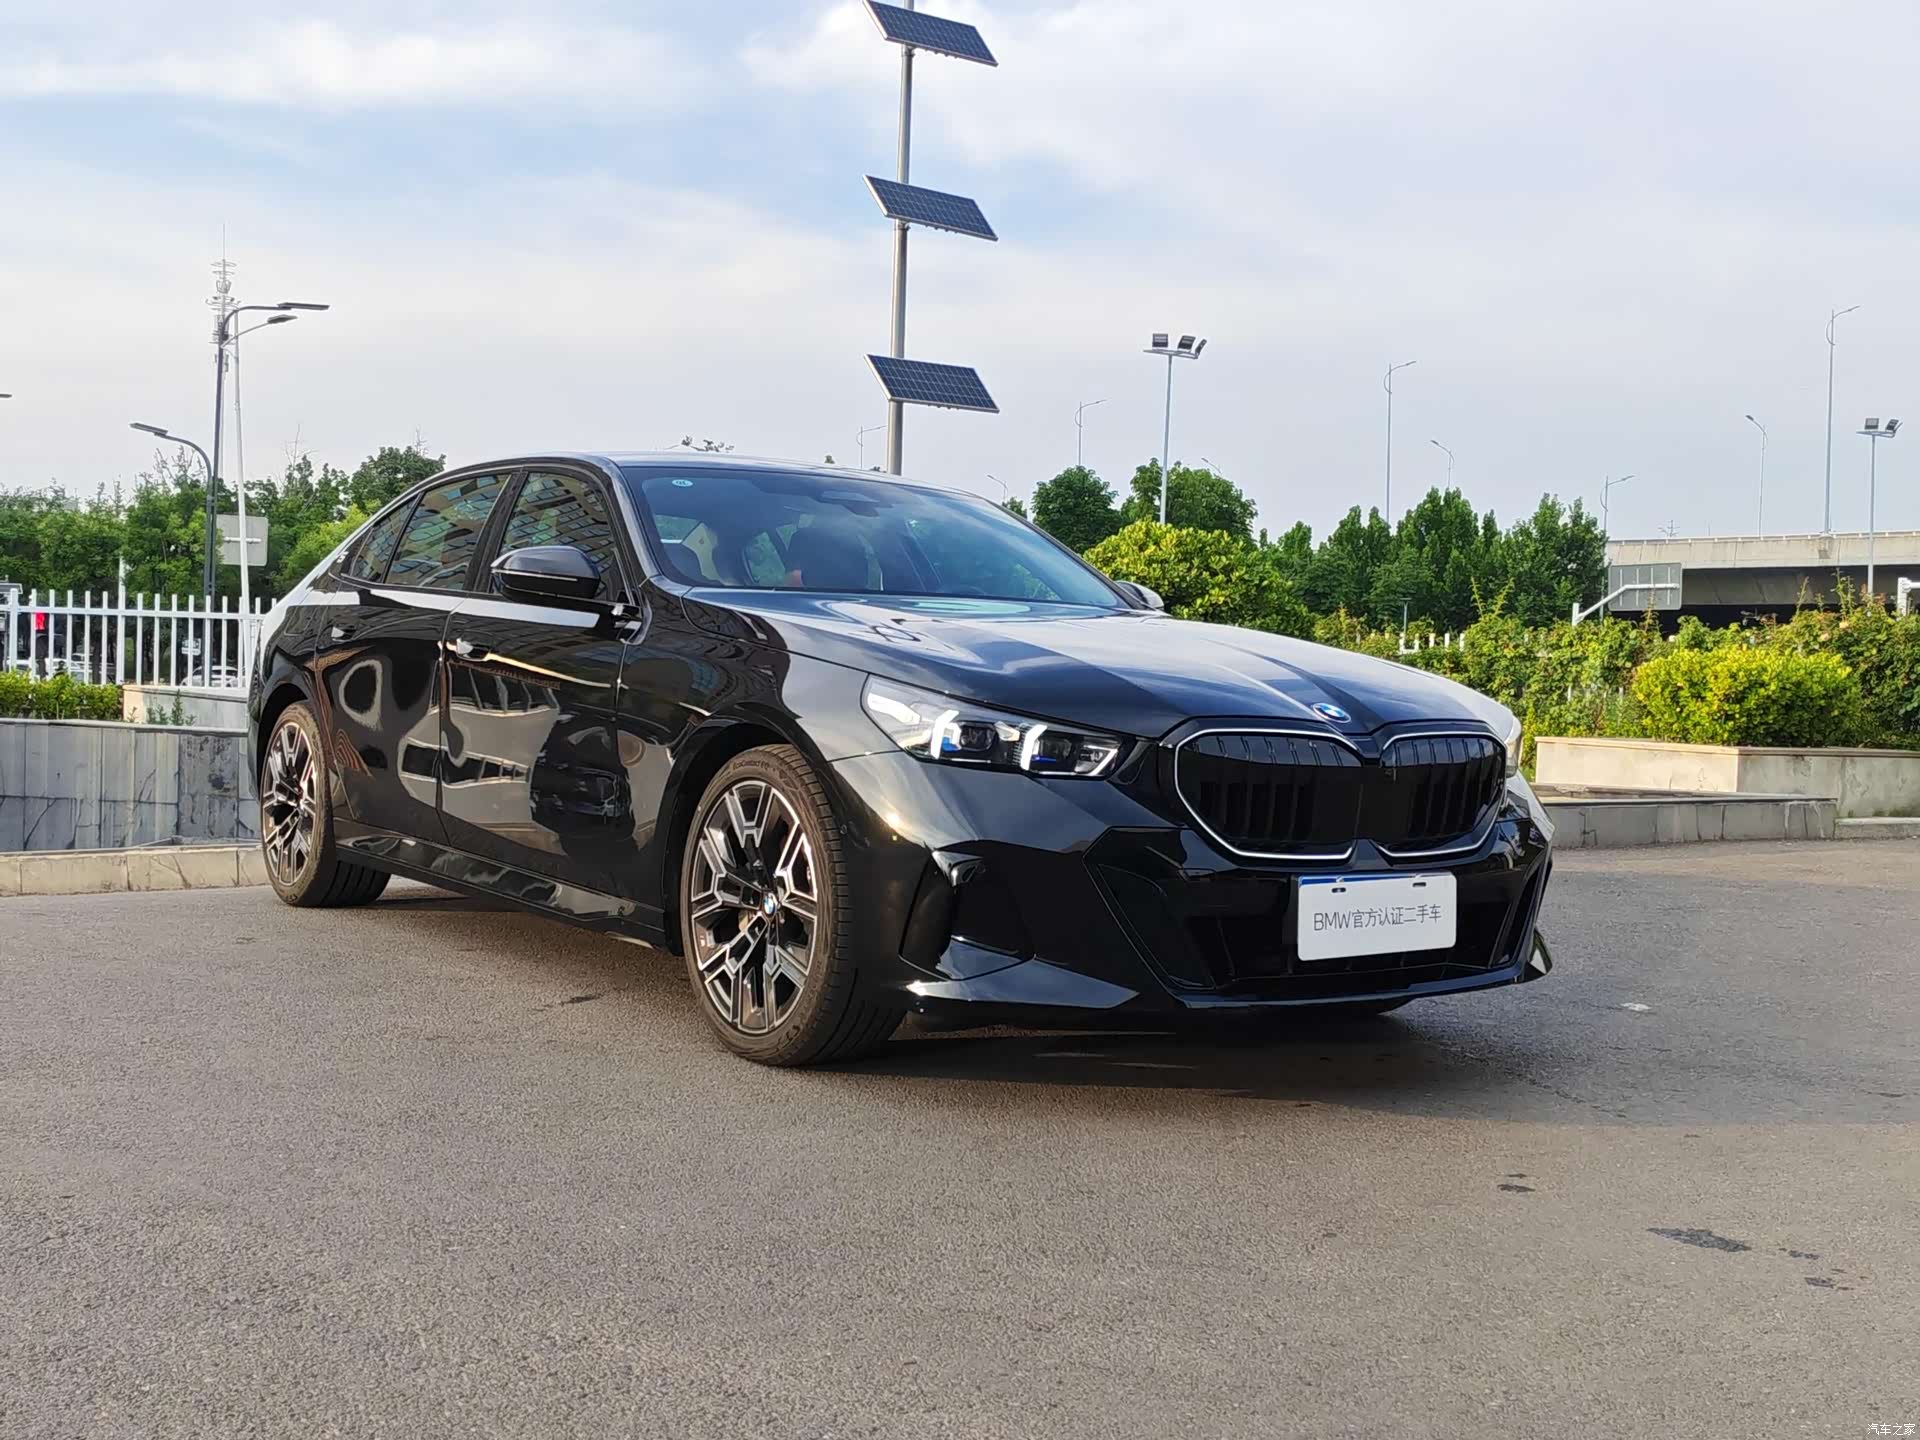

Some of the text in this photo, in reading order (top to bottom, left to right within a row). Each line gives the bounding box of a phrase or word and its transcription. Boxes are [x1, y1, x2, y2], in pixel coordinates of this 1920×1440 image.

[1313, 904, 1442, 931] BMW官方认证二手车
